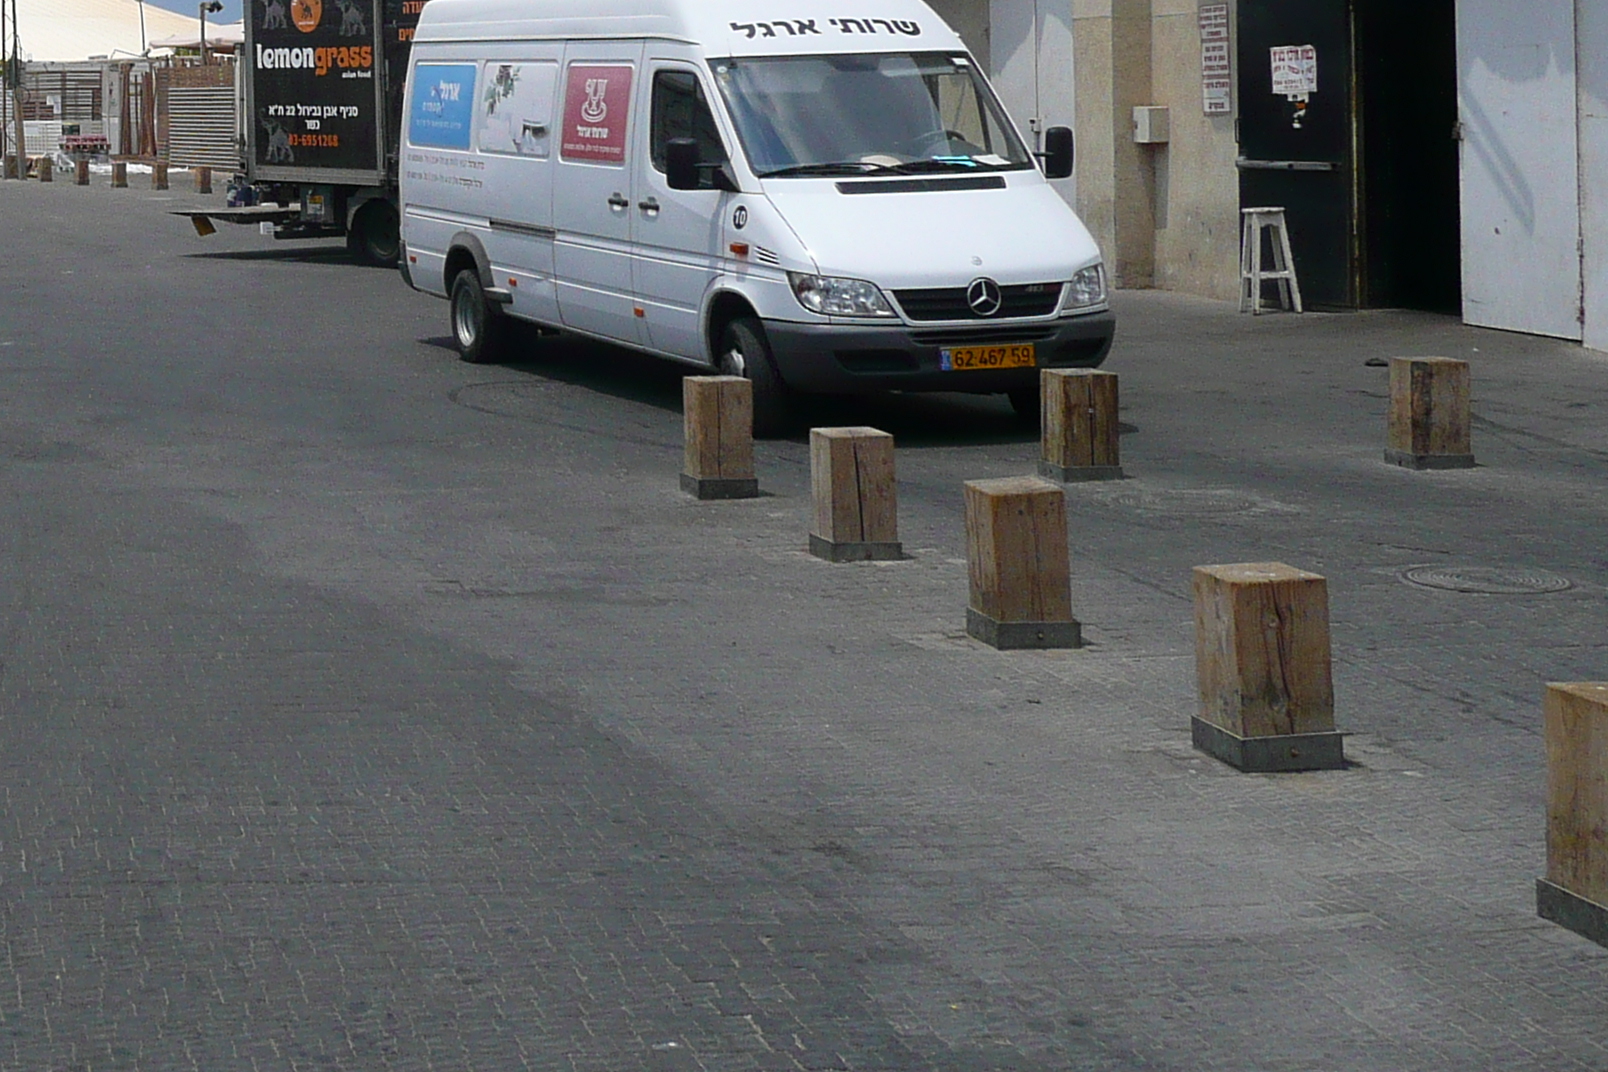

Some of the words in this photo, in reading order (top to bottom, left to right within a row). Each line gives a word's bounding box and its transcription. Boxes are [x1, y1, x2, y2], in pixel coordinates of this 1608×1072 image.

[729, 19, 822, 39] ארגל
[828, 18, 921, 37] שרותי
[256, 43, 372, 77] lemongrass
[735, 209, 747, 226] 10
